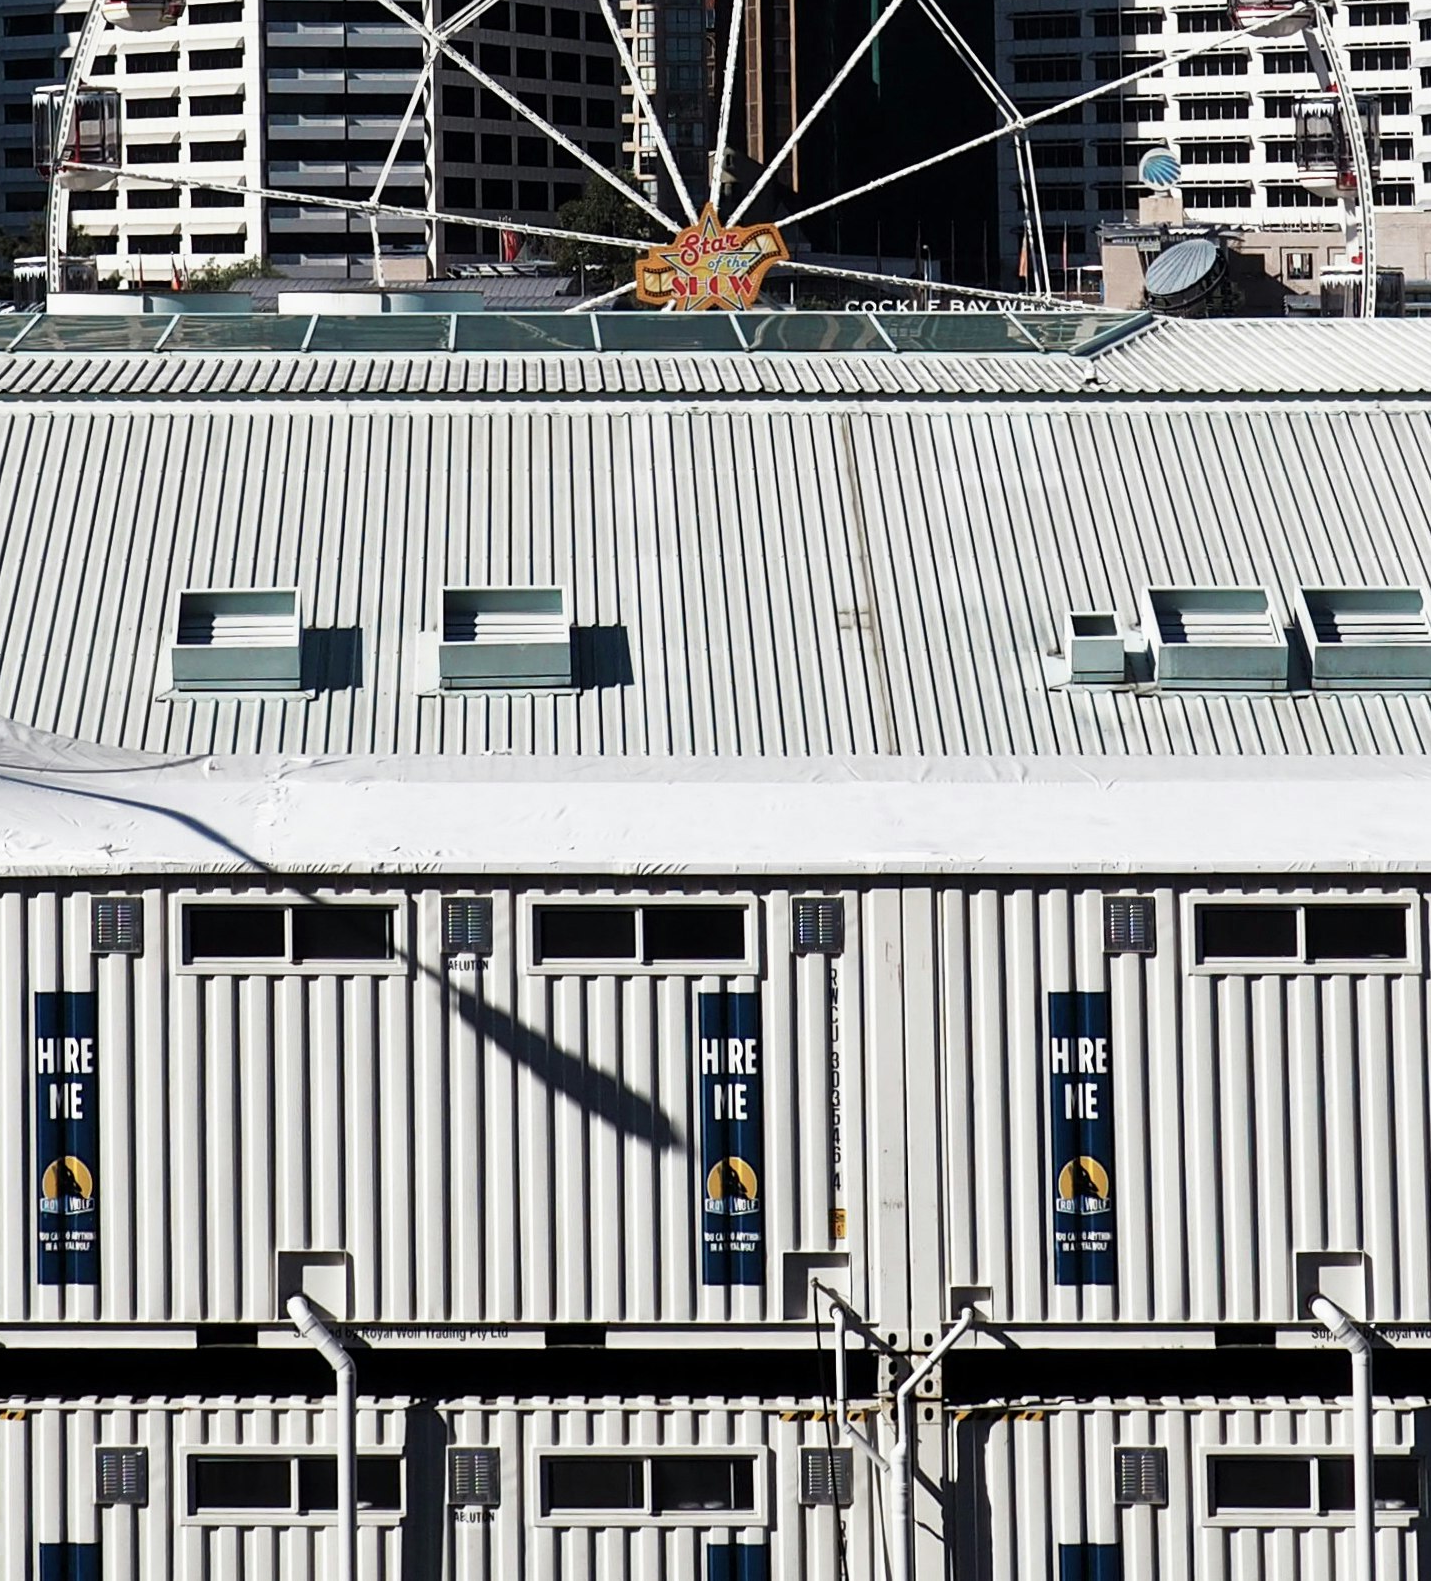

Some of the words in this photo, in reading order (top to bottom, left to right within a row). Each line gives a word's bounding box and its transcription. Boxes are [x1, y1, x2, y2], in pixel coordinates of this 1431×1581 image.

[680, 232, 740, 266] Star
[707, 255, 723, 273] of
[726, 255, 748, 268] the
[672, 274, 754, 297] SHOW
[362, 1327, 393, 1340] Royal
[397, 1327, 420, 1338] Wolf
[425, 1327, 466, 1341] Trading
[470, 1327, 487, 1340] Pty
[491, 1327, 508, 1338] Ltd
[1381, 1327, 1411, 1340] Royal
